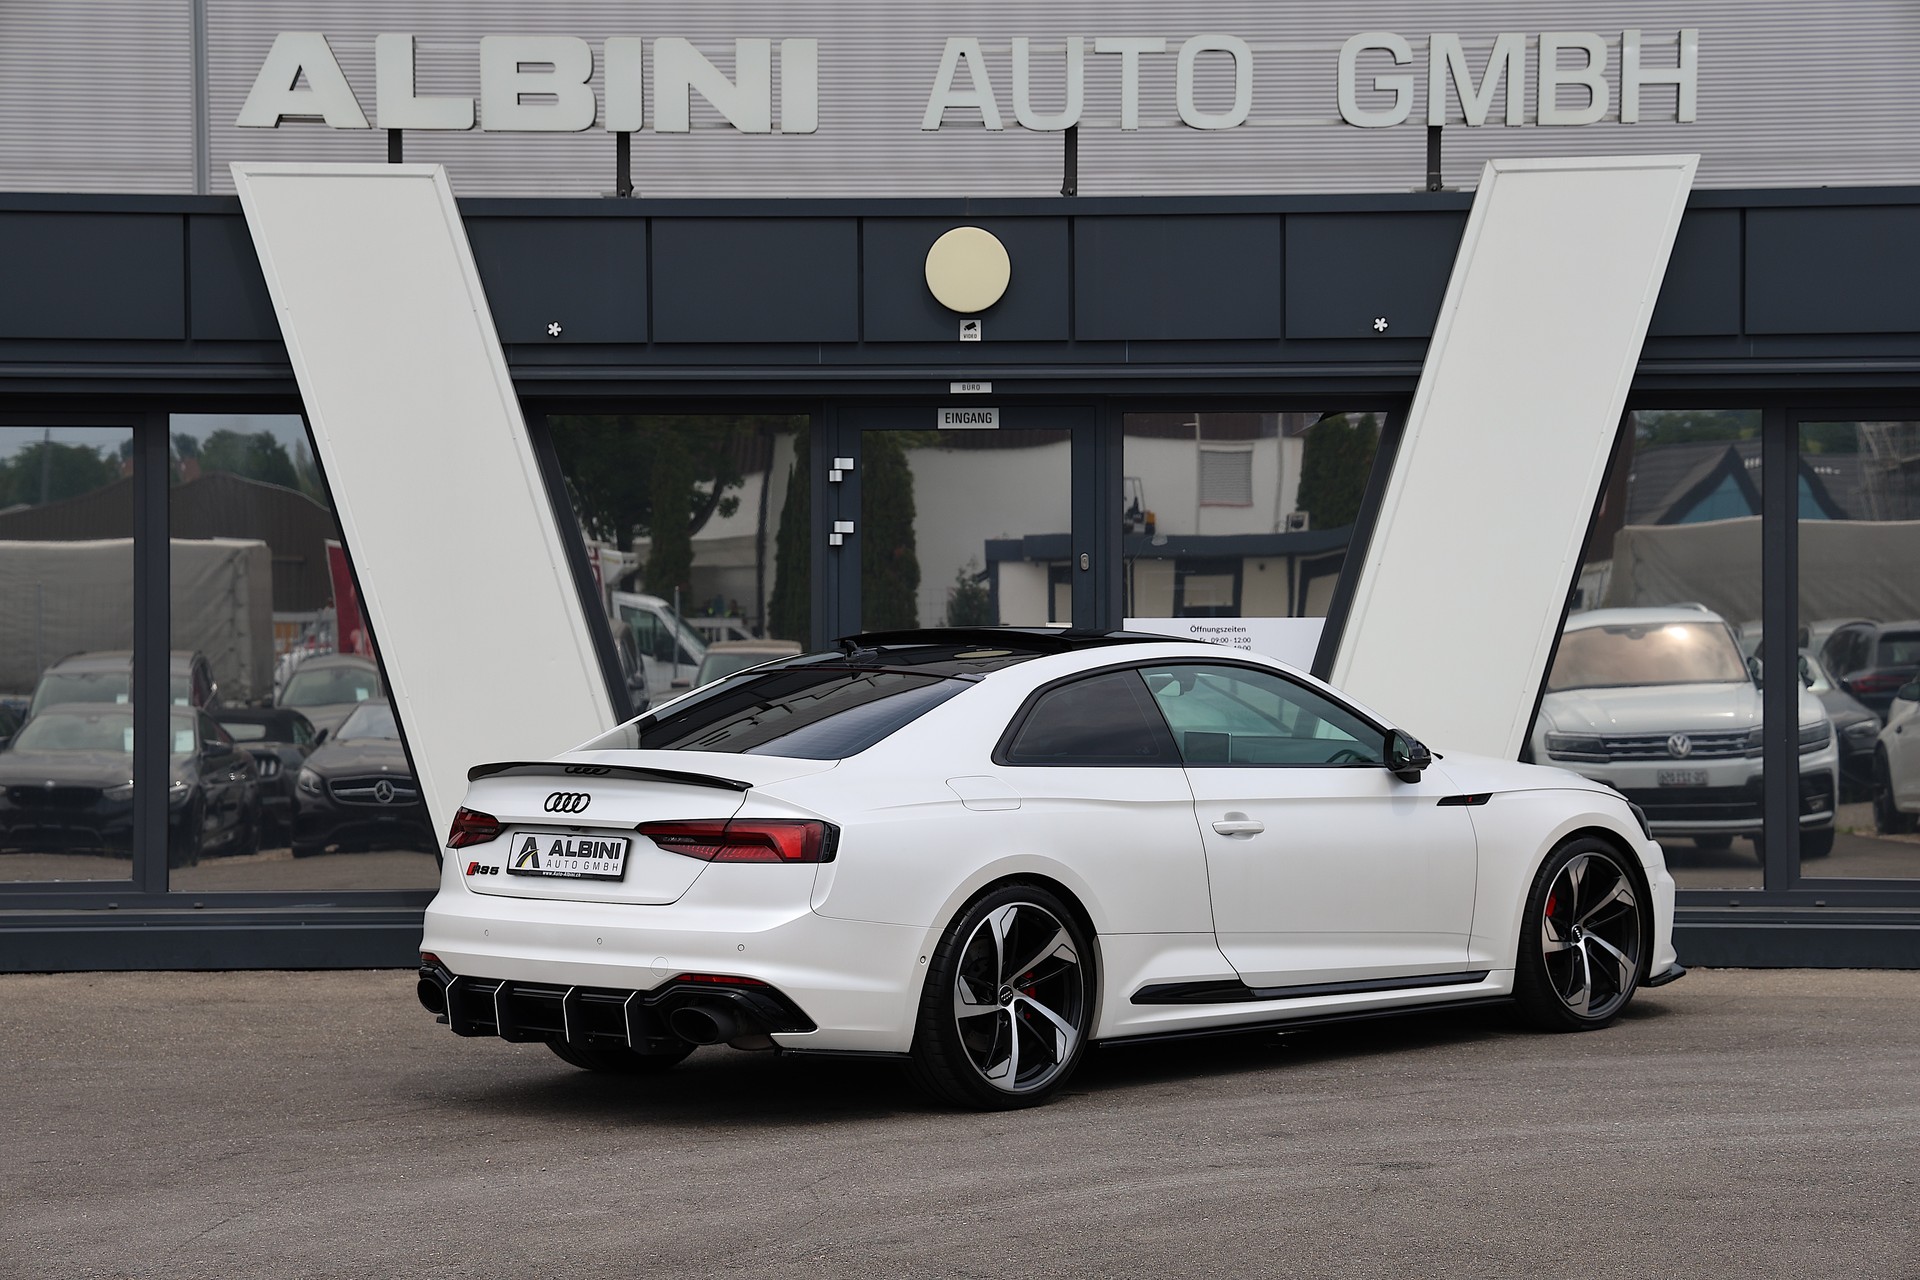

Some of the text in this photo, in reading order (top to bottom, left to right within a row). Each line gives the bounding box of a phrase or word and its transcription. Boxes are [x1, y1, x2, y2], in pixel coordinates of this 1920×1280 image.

[235, 28, 1699, 134] ALBINI AUTO GMBH
[961, 383, 981, 391] BÜRO
[945, 412, 992, 424] EINGANG
[1190, 624, 1247, 634] Öffnungszeiten
[548, 839, 622, 859] ALBINI
[546, 859, 619, 872] AUTO GMBH
